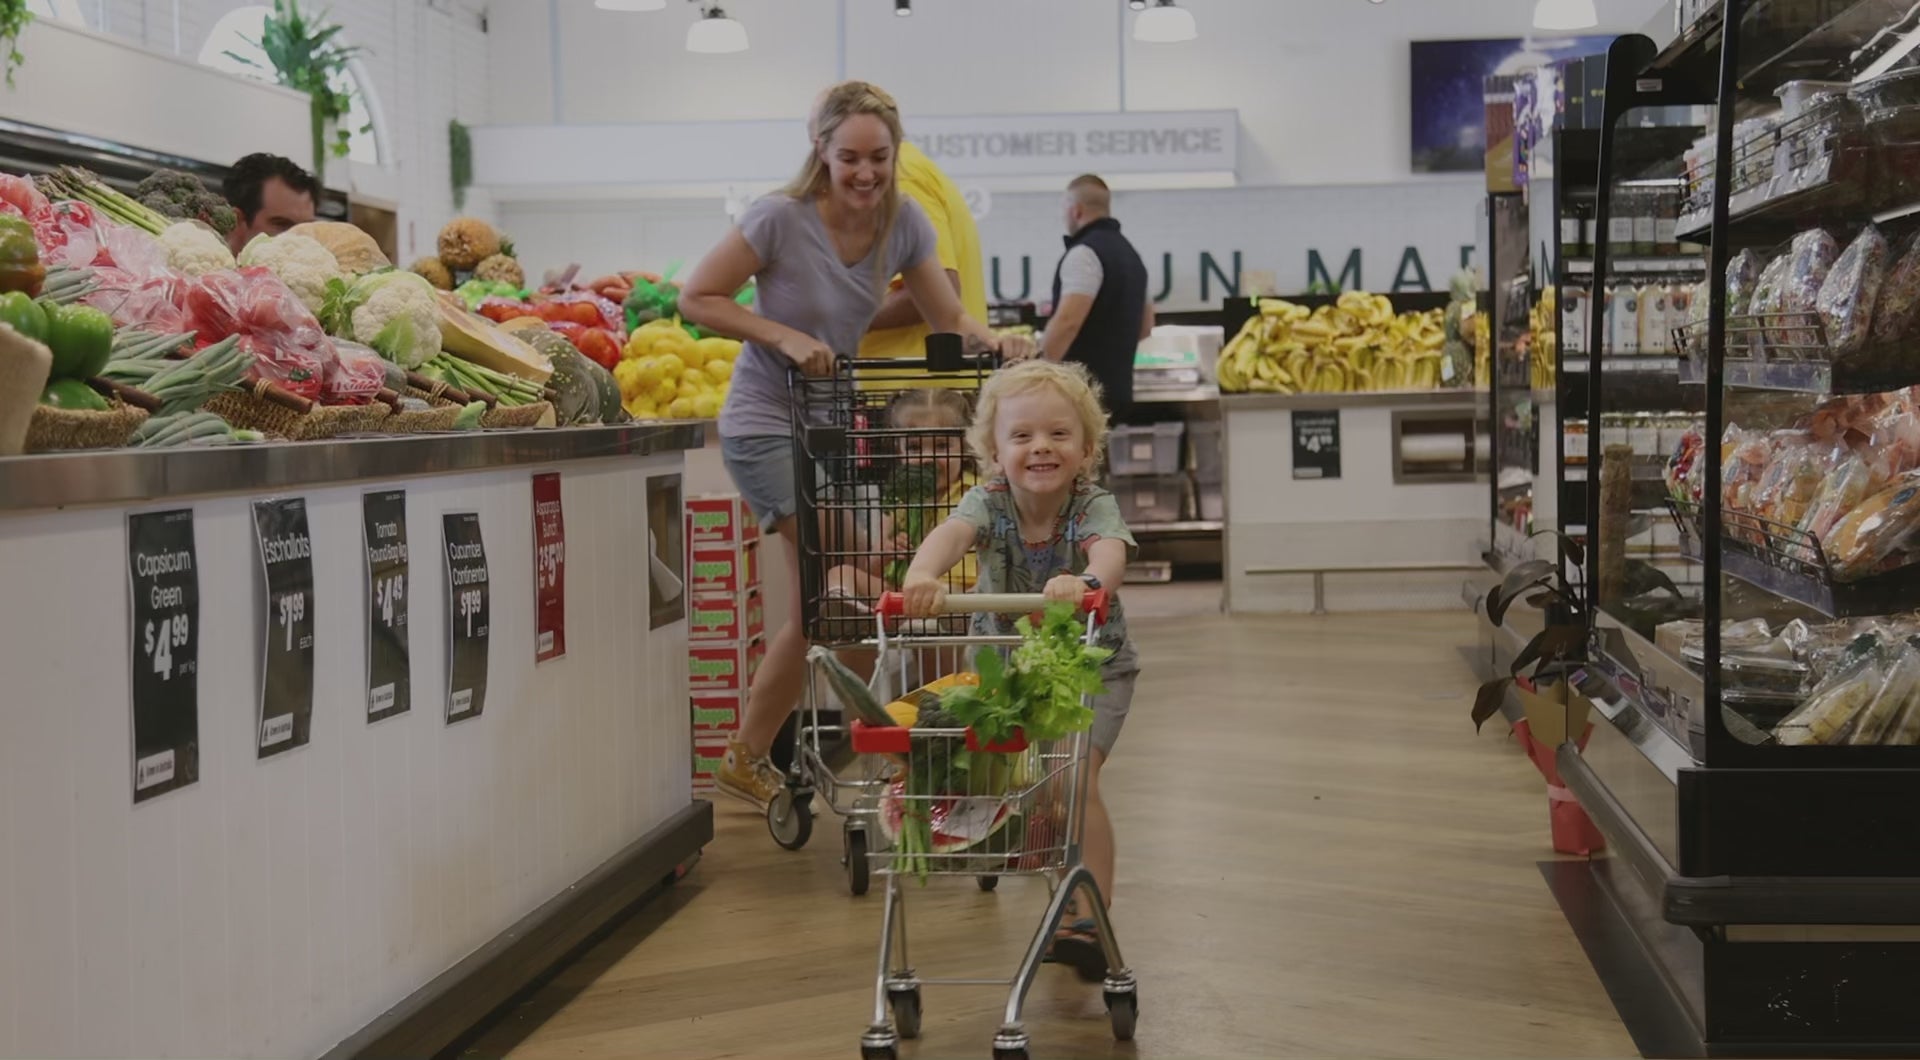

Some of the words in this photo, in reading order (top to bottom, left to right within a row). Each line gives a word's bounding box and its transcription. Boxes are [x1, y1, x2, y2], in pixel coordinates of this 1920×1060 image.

[1085, 127, 1223, 155] SERVICE
[375, 521, 398, 540] Tomato
[263, 532, 310, 564] Eschallots
[137, 547, 191, 582] Capsicum
[452, 565, 487, 586] Continental
[151, 585, 182, 610] Green
